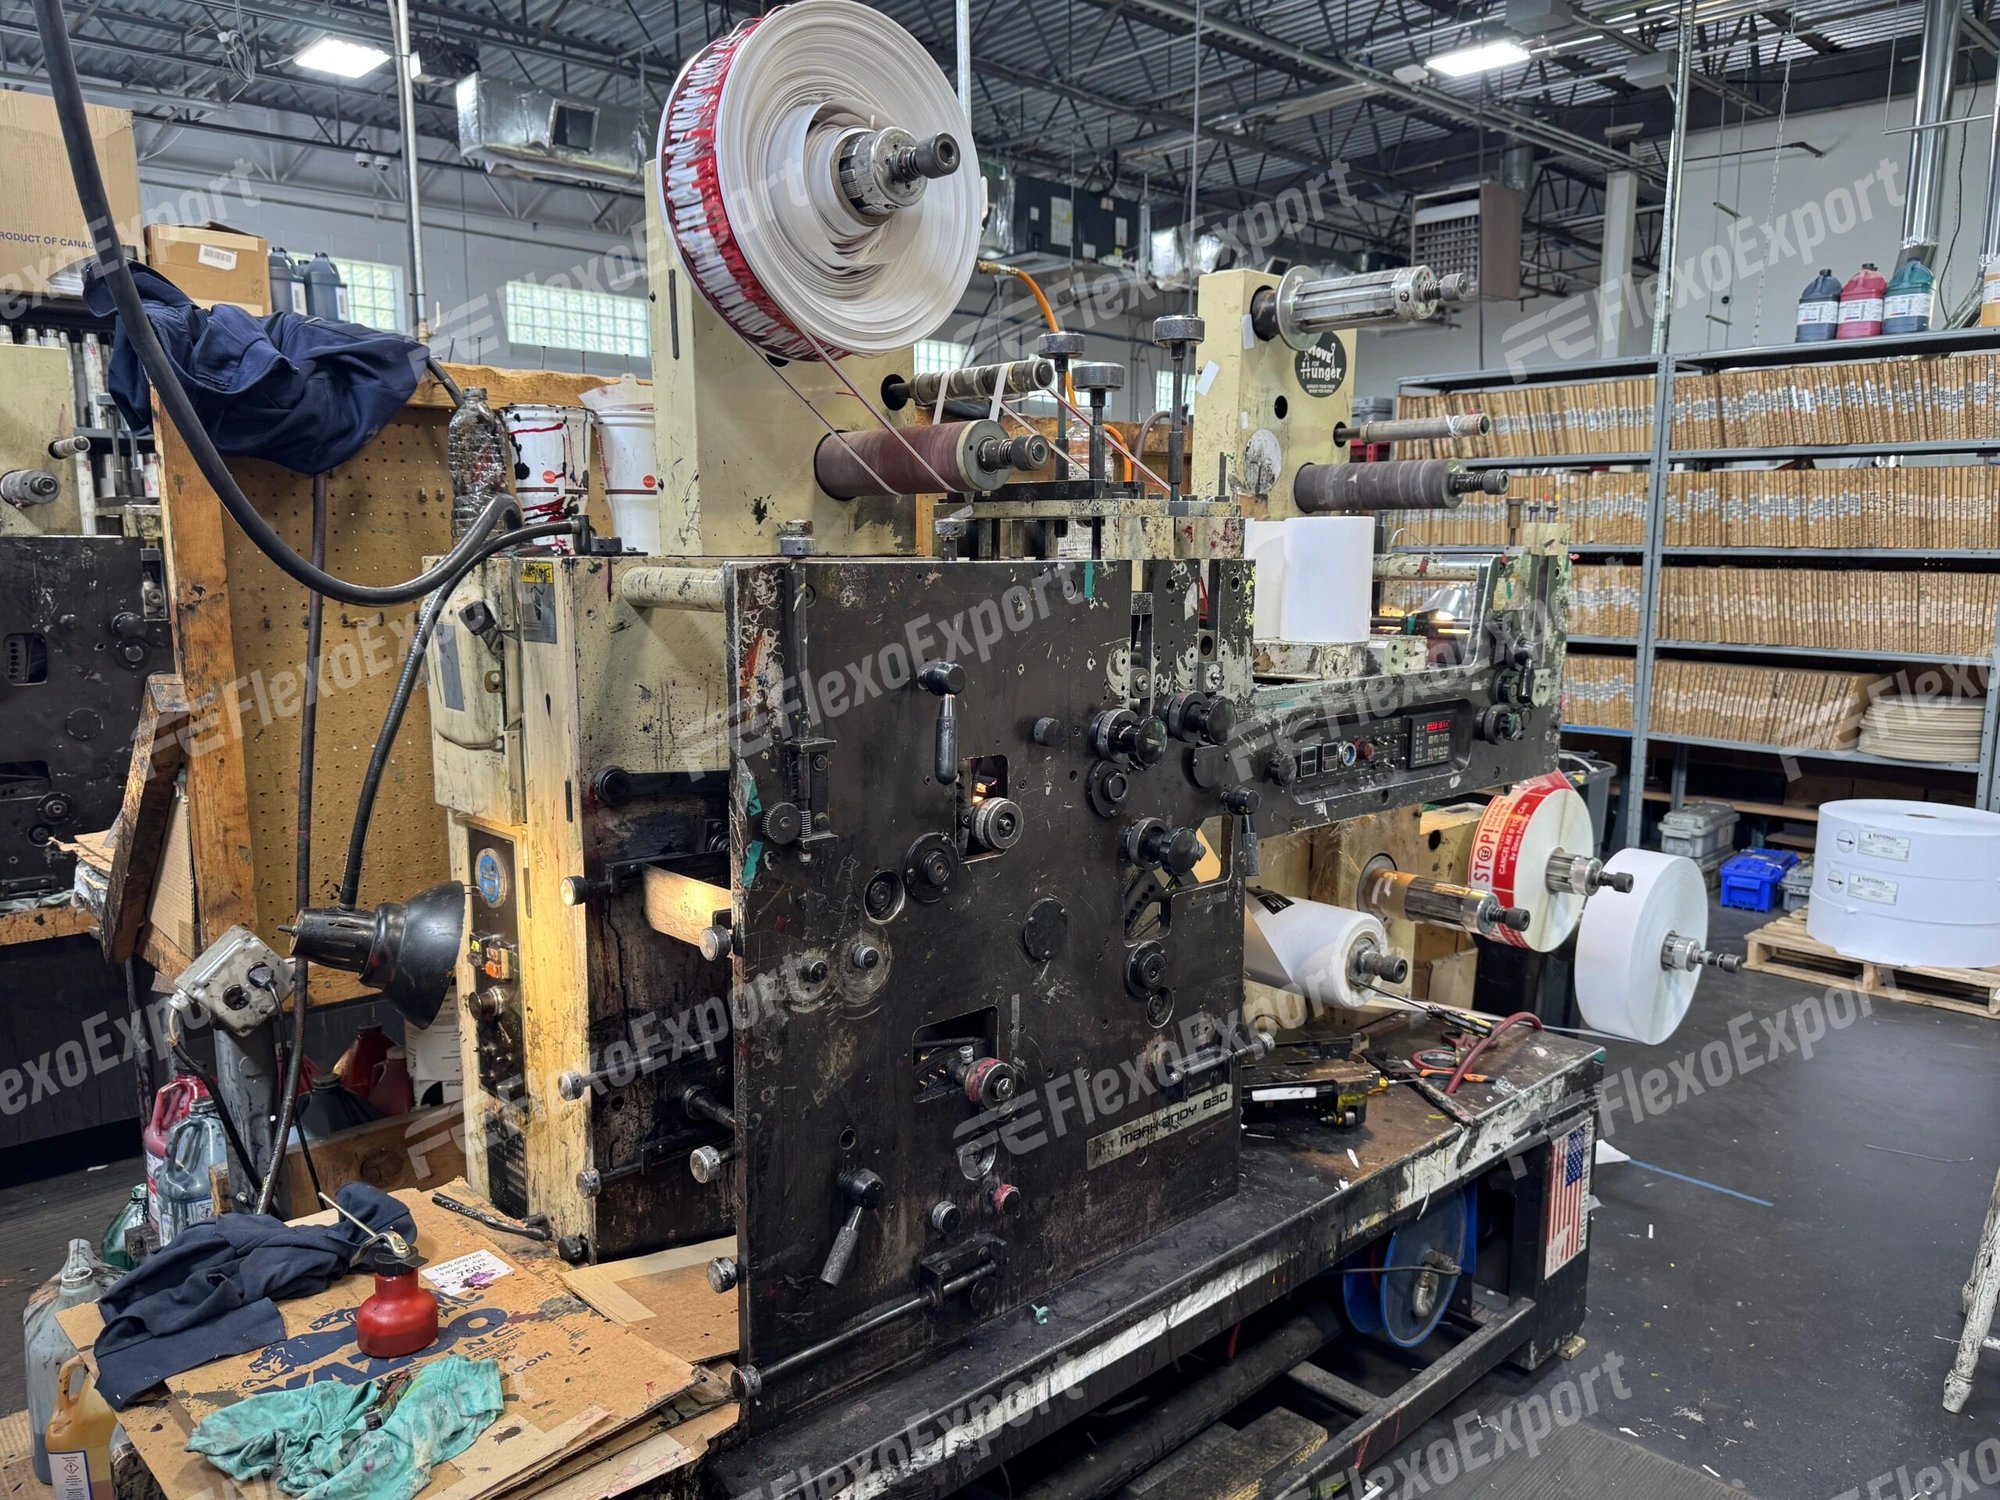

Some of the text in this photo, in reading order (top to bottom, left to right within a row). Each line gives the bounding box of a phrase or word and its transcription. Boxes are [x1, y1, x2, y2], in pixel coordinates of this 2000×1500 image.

[44, 236, 58, 246] OF
[60, 238, 94, 250] CANAD
[1300, 361, 1342, 381] Hunger
[1517, 802, 1530, 814] CAN
[1504, 835, 1512, 845] ME
[1511, 835, 1521, 851] Dave
[1499, 846, 1510, 875] CANCEL
[1509, 852, 1517, 861] By
[1203, 1091, 1228, 1110] 830
[1578, 1219, 1587, 1247] USA
[473, 1331, 526, 1358] AND CORES
